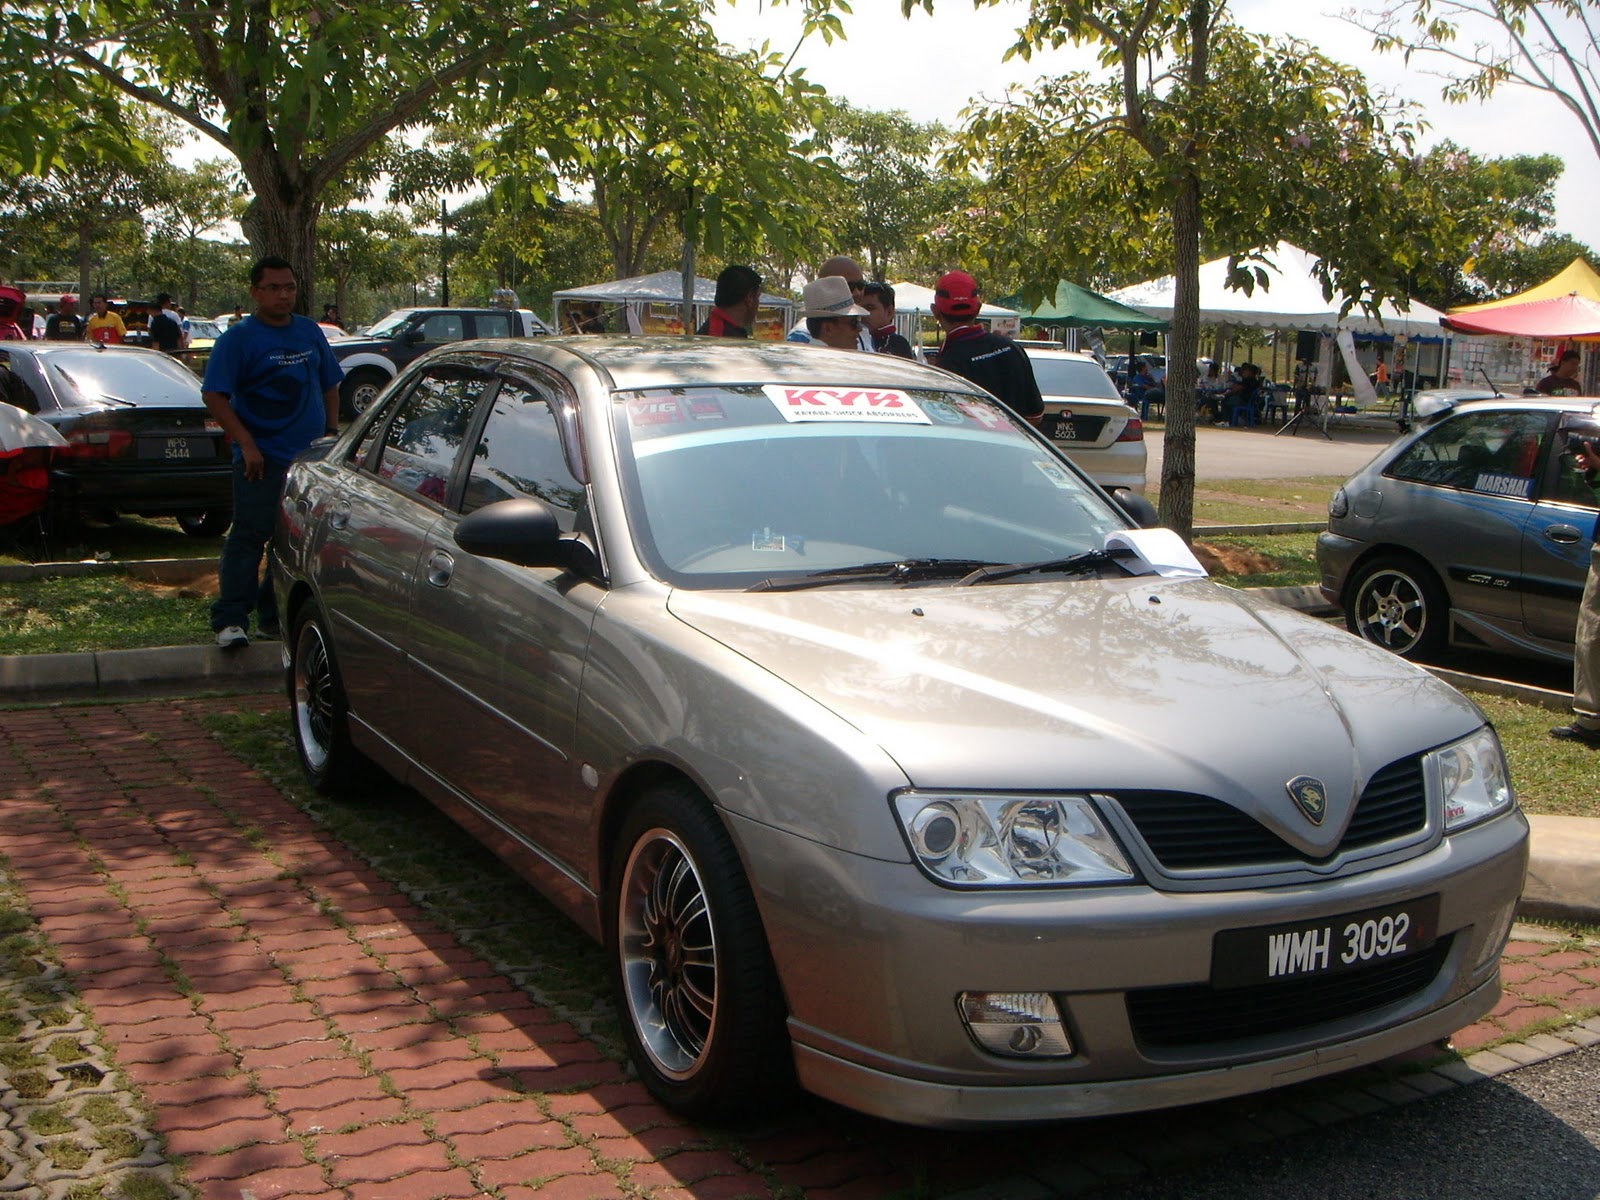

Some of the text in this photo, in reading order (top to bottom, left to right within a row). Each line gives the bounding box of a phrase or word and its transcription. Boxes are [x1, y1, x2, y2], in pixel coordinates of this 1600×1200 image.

[784, 389, 904, 408] KYB
[965, 405, 998, 428] P
[1056, 422, 1074, 431] WNC
[1054, 431, 1076, 439] 5623
[167, 438, 187, 448] WPG
[165, 448, 190, 459] 5444
[1474, 473, 1530, 497] MARSHAL
[1291, 780, 1322, 790] PROTON
[1268, 912, 1410, 977] WMH 3092
